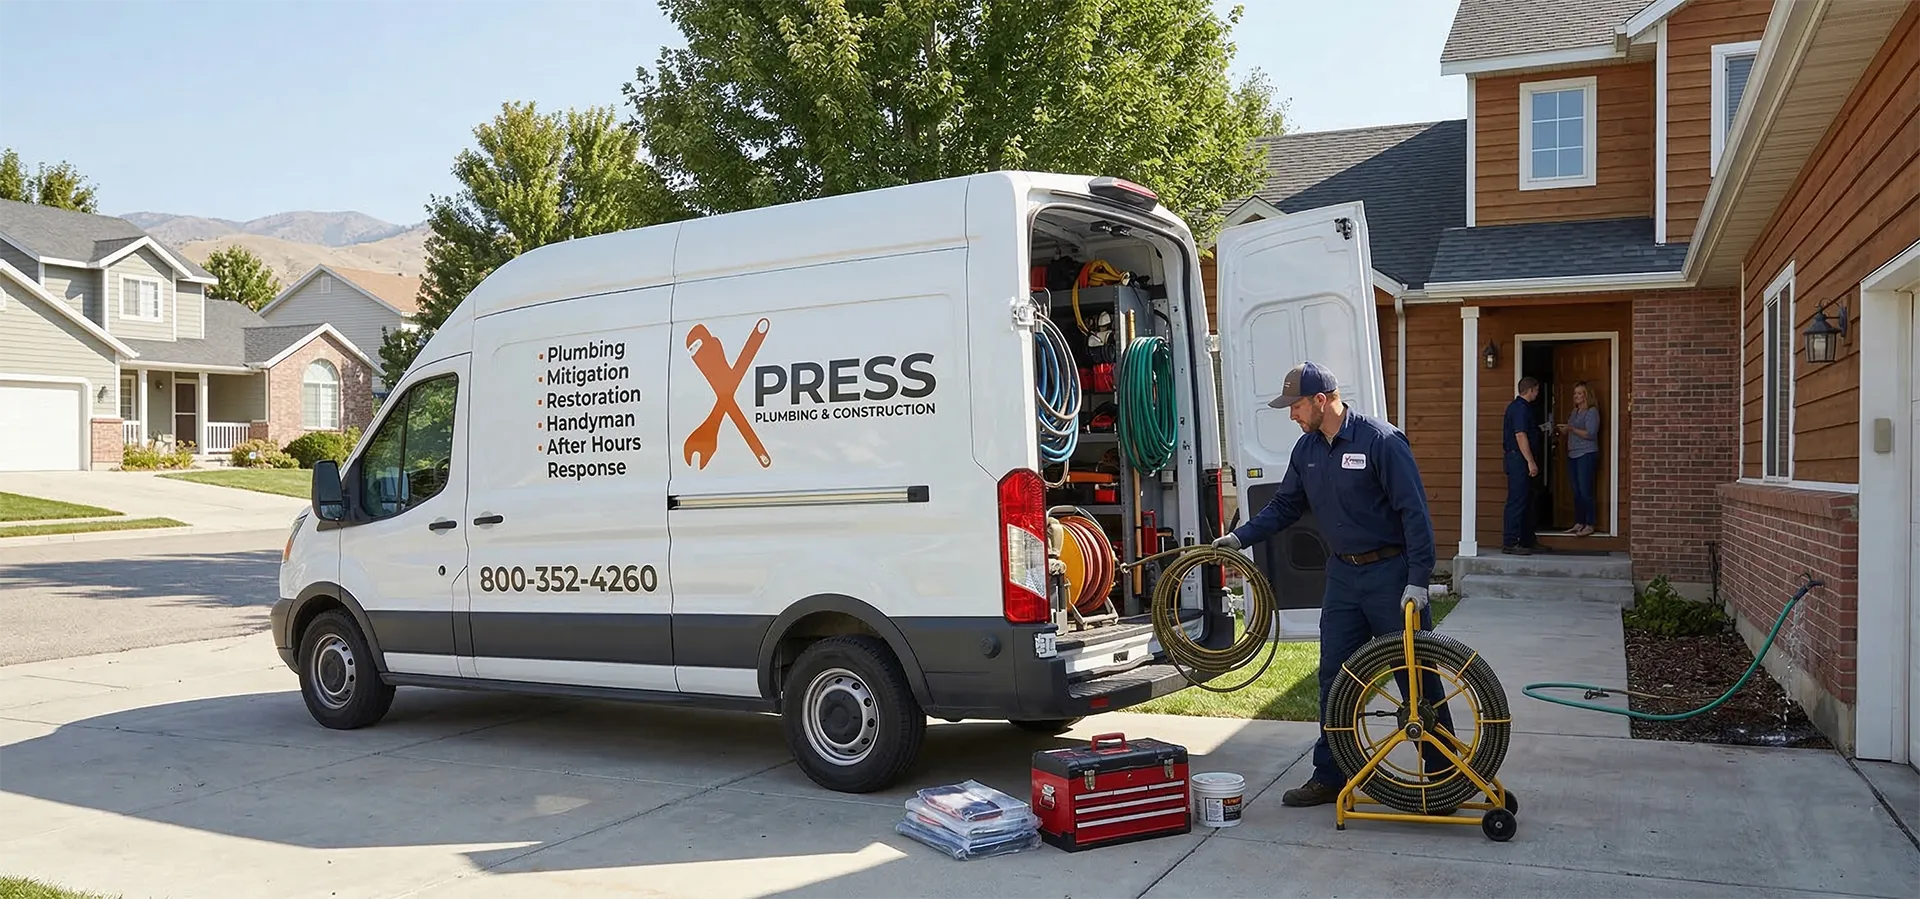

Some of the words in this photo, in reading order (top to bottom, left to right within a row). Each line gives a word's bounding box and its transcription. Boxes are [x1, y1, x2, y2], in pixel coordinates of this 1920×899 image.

[547, 339, 625, 364] Plumbing
[547, 361, 629, 388] Mitigation
[547, 385, 641, 409] Restoration
[547, 411, 635, 434] Handyman
[755, 409, 818, 424] PLUMBING
[821, 407, 830, 420] &
[832, 402, 936, 420] CONSTRUCTION
[547, 436, 588, 456] After
[591, 435, 642, 453] Hours
[547, 461, 627, 481] Response
[479, 564, 658, 593] 800-352-4260
